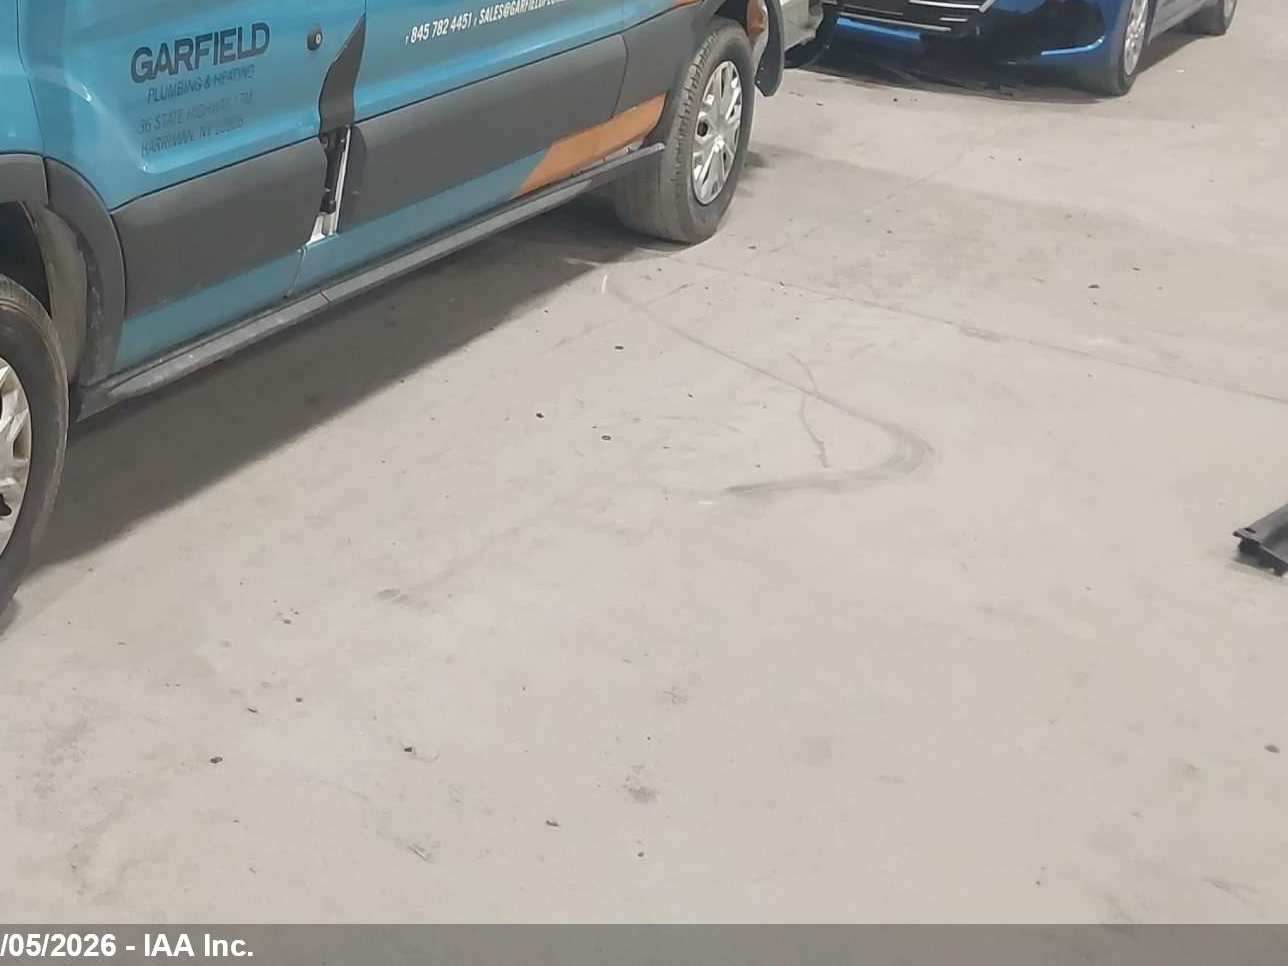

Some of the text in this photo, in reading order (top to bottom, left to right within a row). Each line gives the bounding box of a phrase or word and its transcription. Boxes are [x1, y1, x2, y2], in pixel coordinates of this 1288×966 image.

[410, 24, 430, 44] 845
[431, 18, 450, 38] 782
[450, 12, 473, 32] 4451
[130, 22, 270, 84] GARFIELD
[147, 77, 202, 103] PLUMBING
